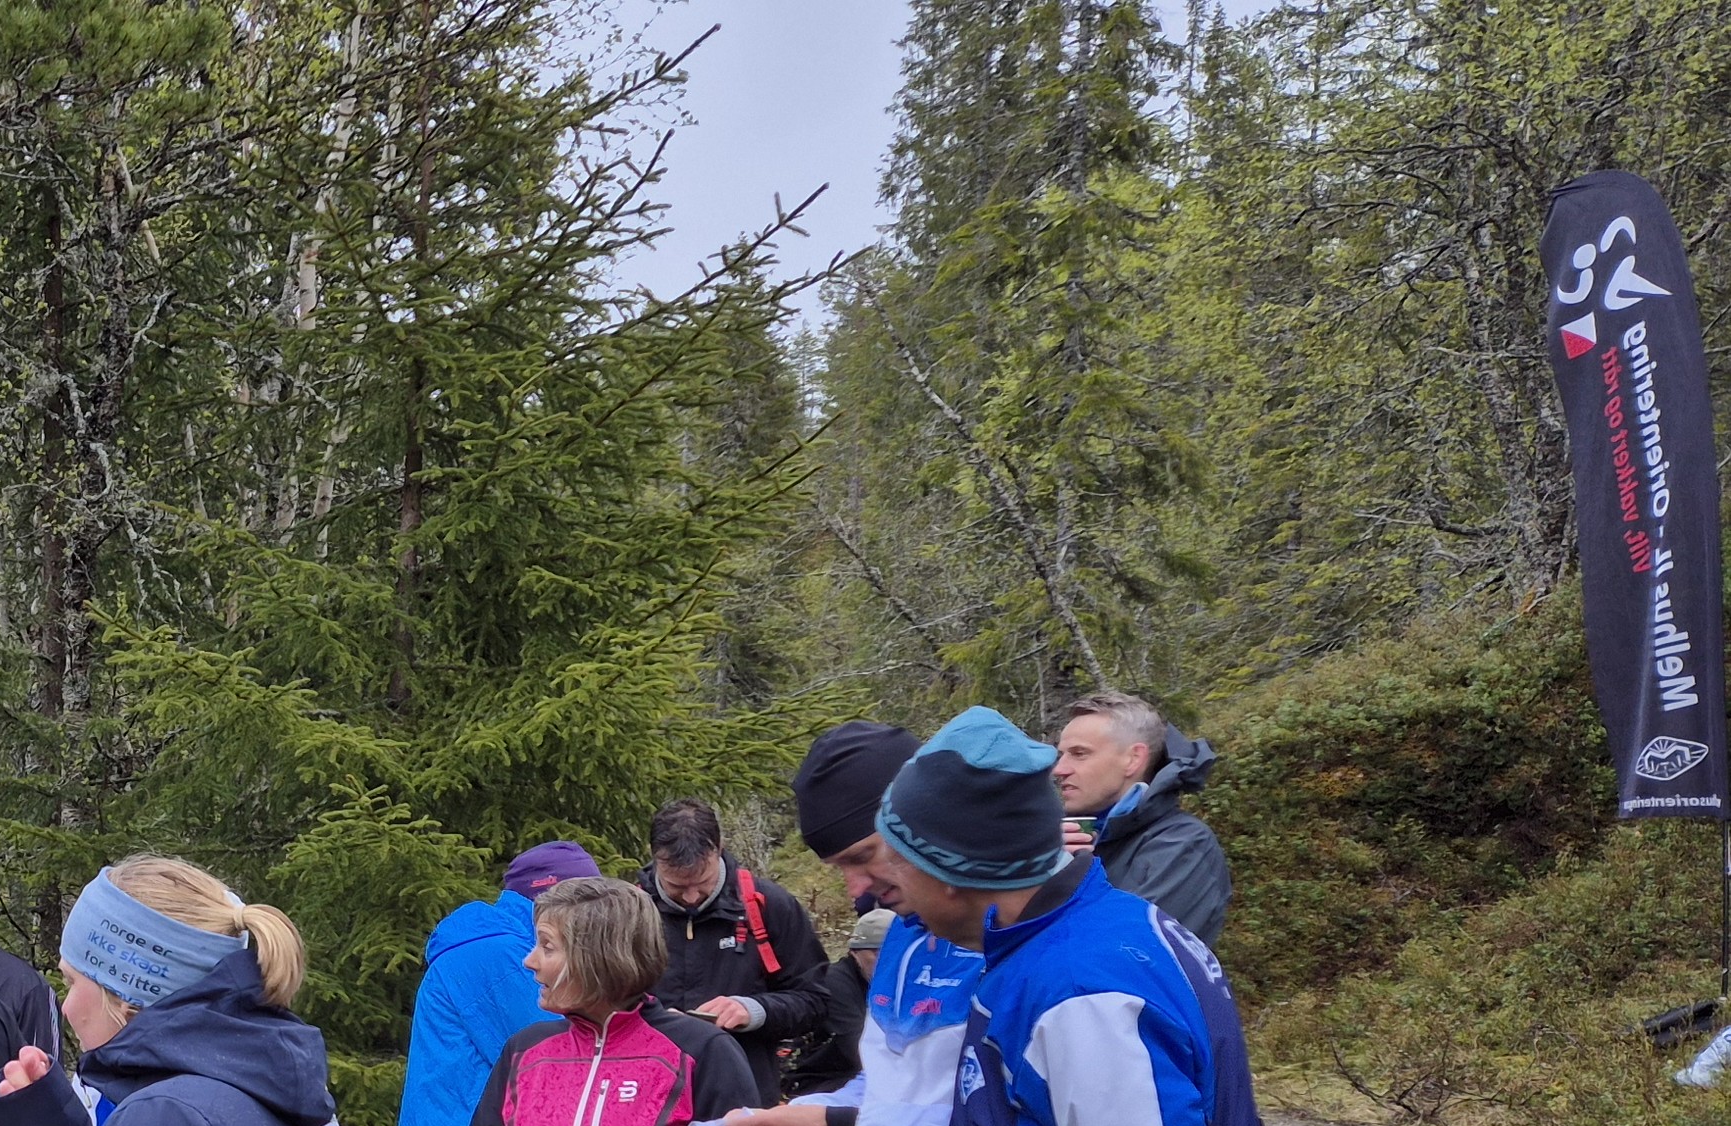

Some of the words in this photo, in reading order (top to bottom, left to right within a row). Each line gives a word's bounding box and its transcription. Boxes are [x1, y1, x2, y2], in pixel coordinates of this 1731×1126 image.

[88, 929, 117, 956] ikke
[119, 951, 170, 979] skapt
[100, 918, 147, 949] norge
[152, 944, 173, 958] er
[84, 950, 105, 968] for
[108, 964, 118, 977] å
[120, 972, 161, 996] sitte
